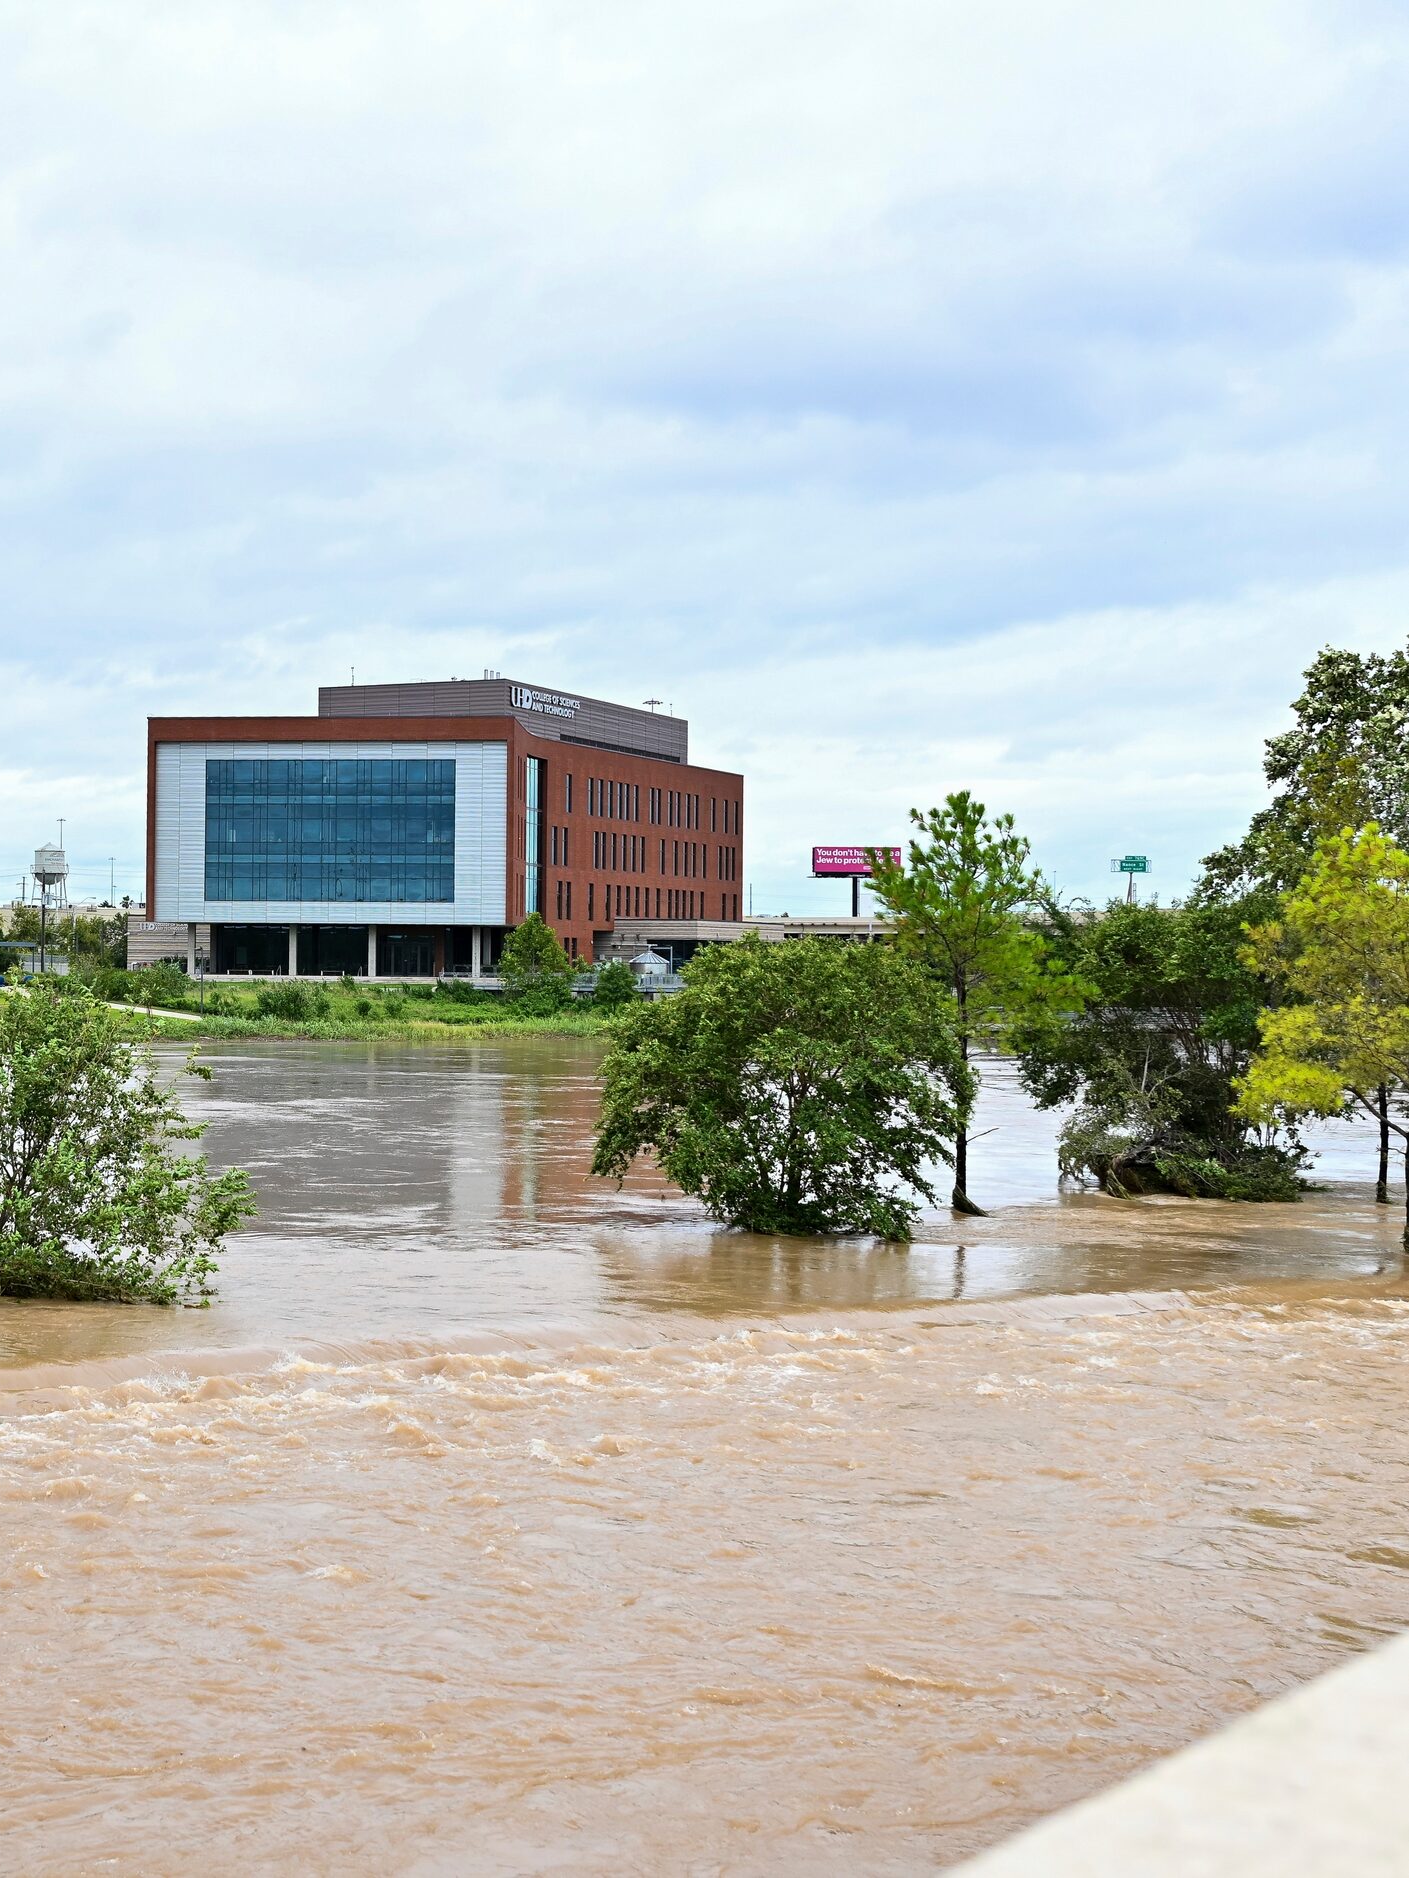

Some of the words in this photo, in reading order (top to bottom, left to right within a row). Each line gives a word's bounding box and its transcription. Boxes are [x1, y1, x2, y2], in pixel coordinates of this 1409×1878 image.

[532, 691, 552, 703] COLLEGE
[552, 695, 559, 705] OF
[559, 697, 580, 709] SCIENCES
[532, 702, 543, 712] AND
[544, 704, 575, 718] TECHNOLOGY
[816, 848, 832, 856] You
[833, 848, 853, 856] don't
[816, 856, 833, 864] Jew
[834, 856, 843, 864] to
